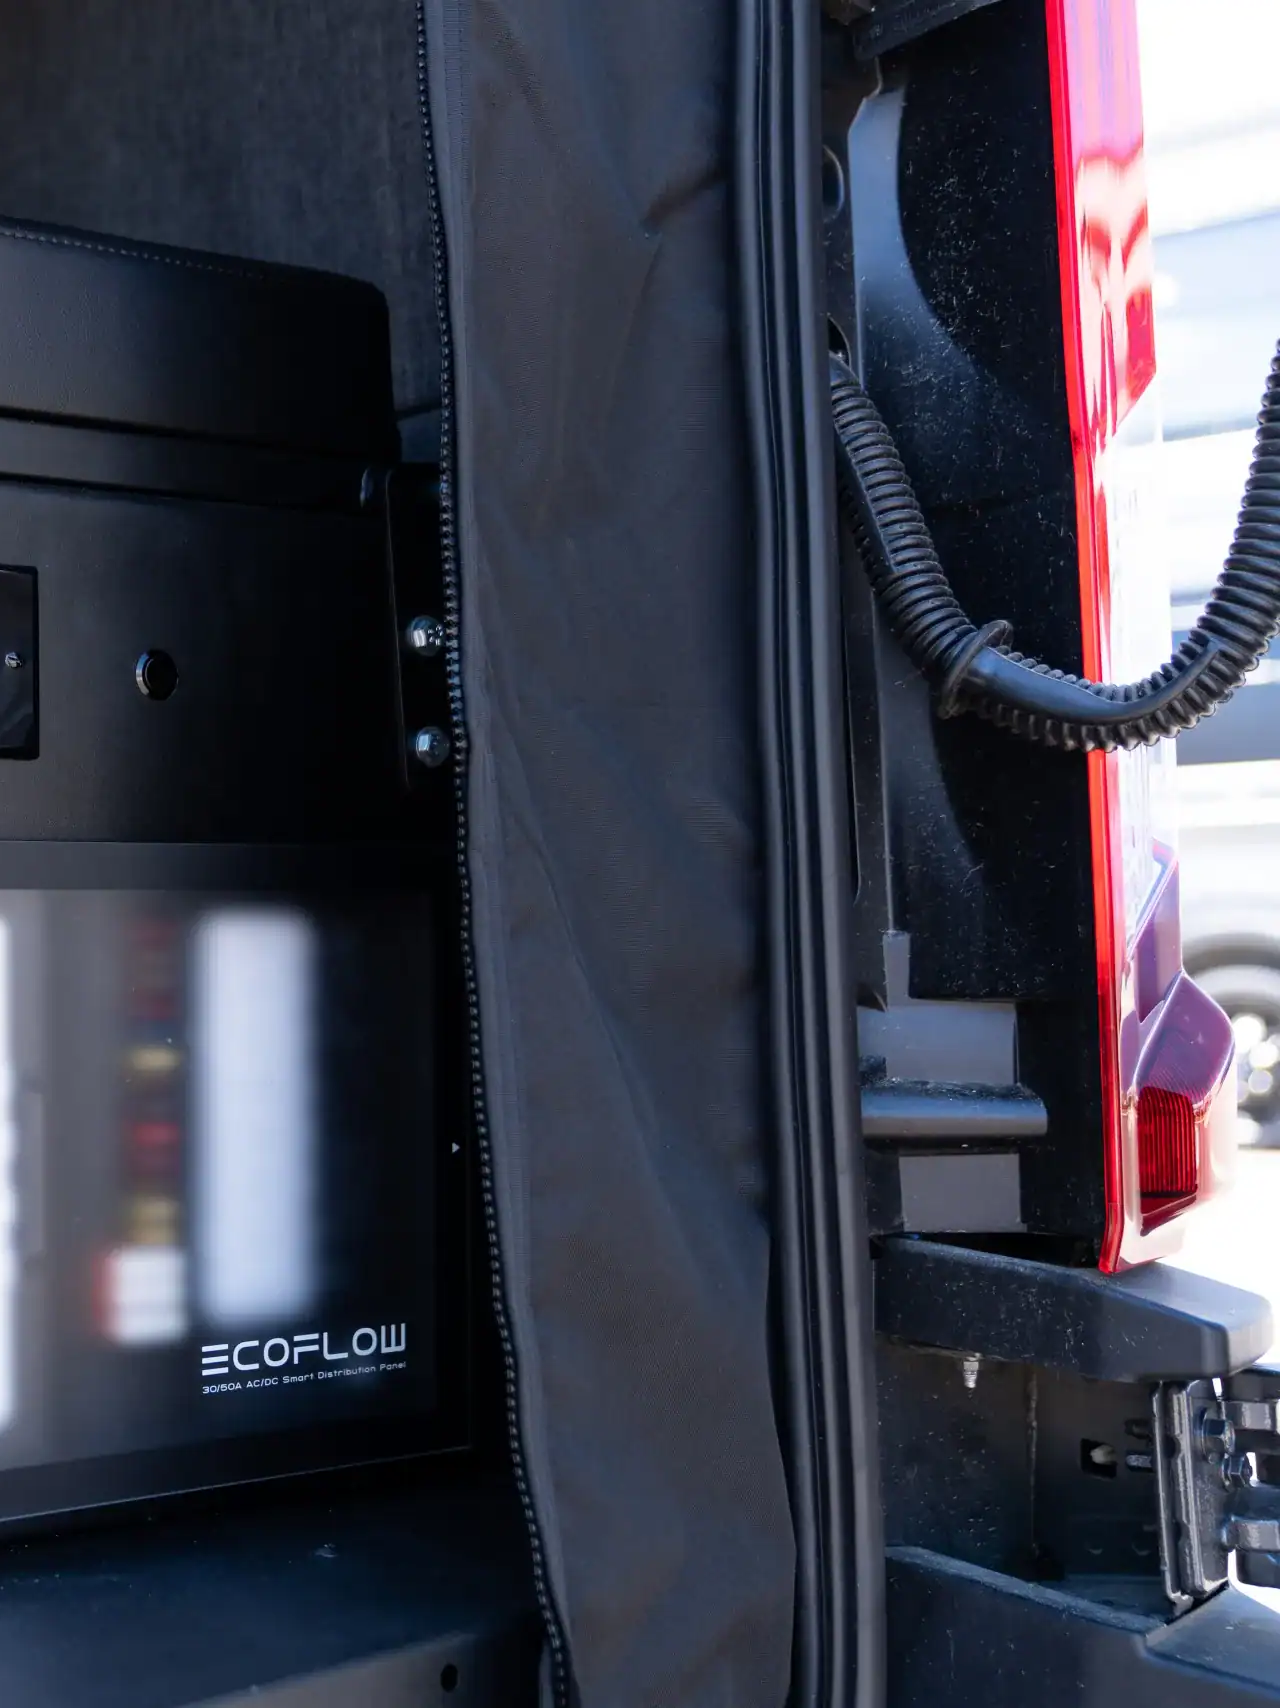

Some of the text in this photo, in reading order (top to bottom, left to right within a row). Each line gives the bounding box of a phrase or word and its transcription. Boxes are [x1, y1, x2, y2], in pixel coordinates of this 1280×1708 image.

[201, 1322, 406, 1376] ECOFLOW
[202, 1361, 406, 1394] 30/50A AC/DC Smart Distribution Panel
